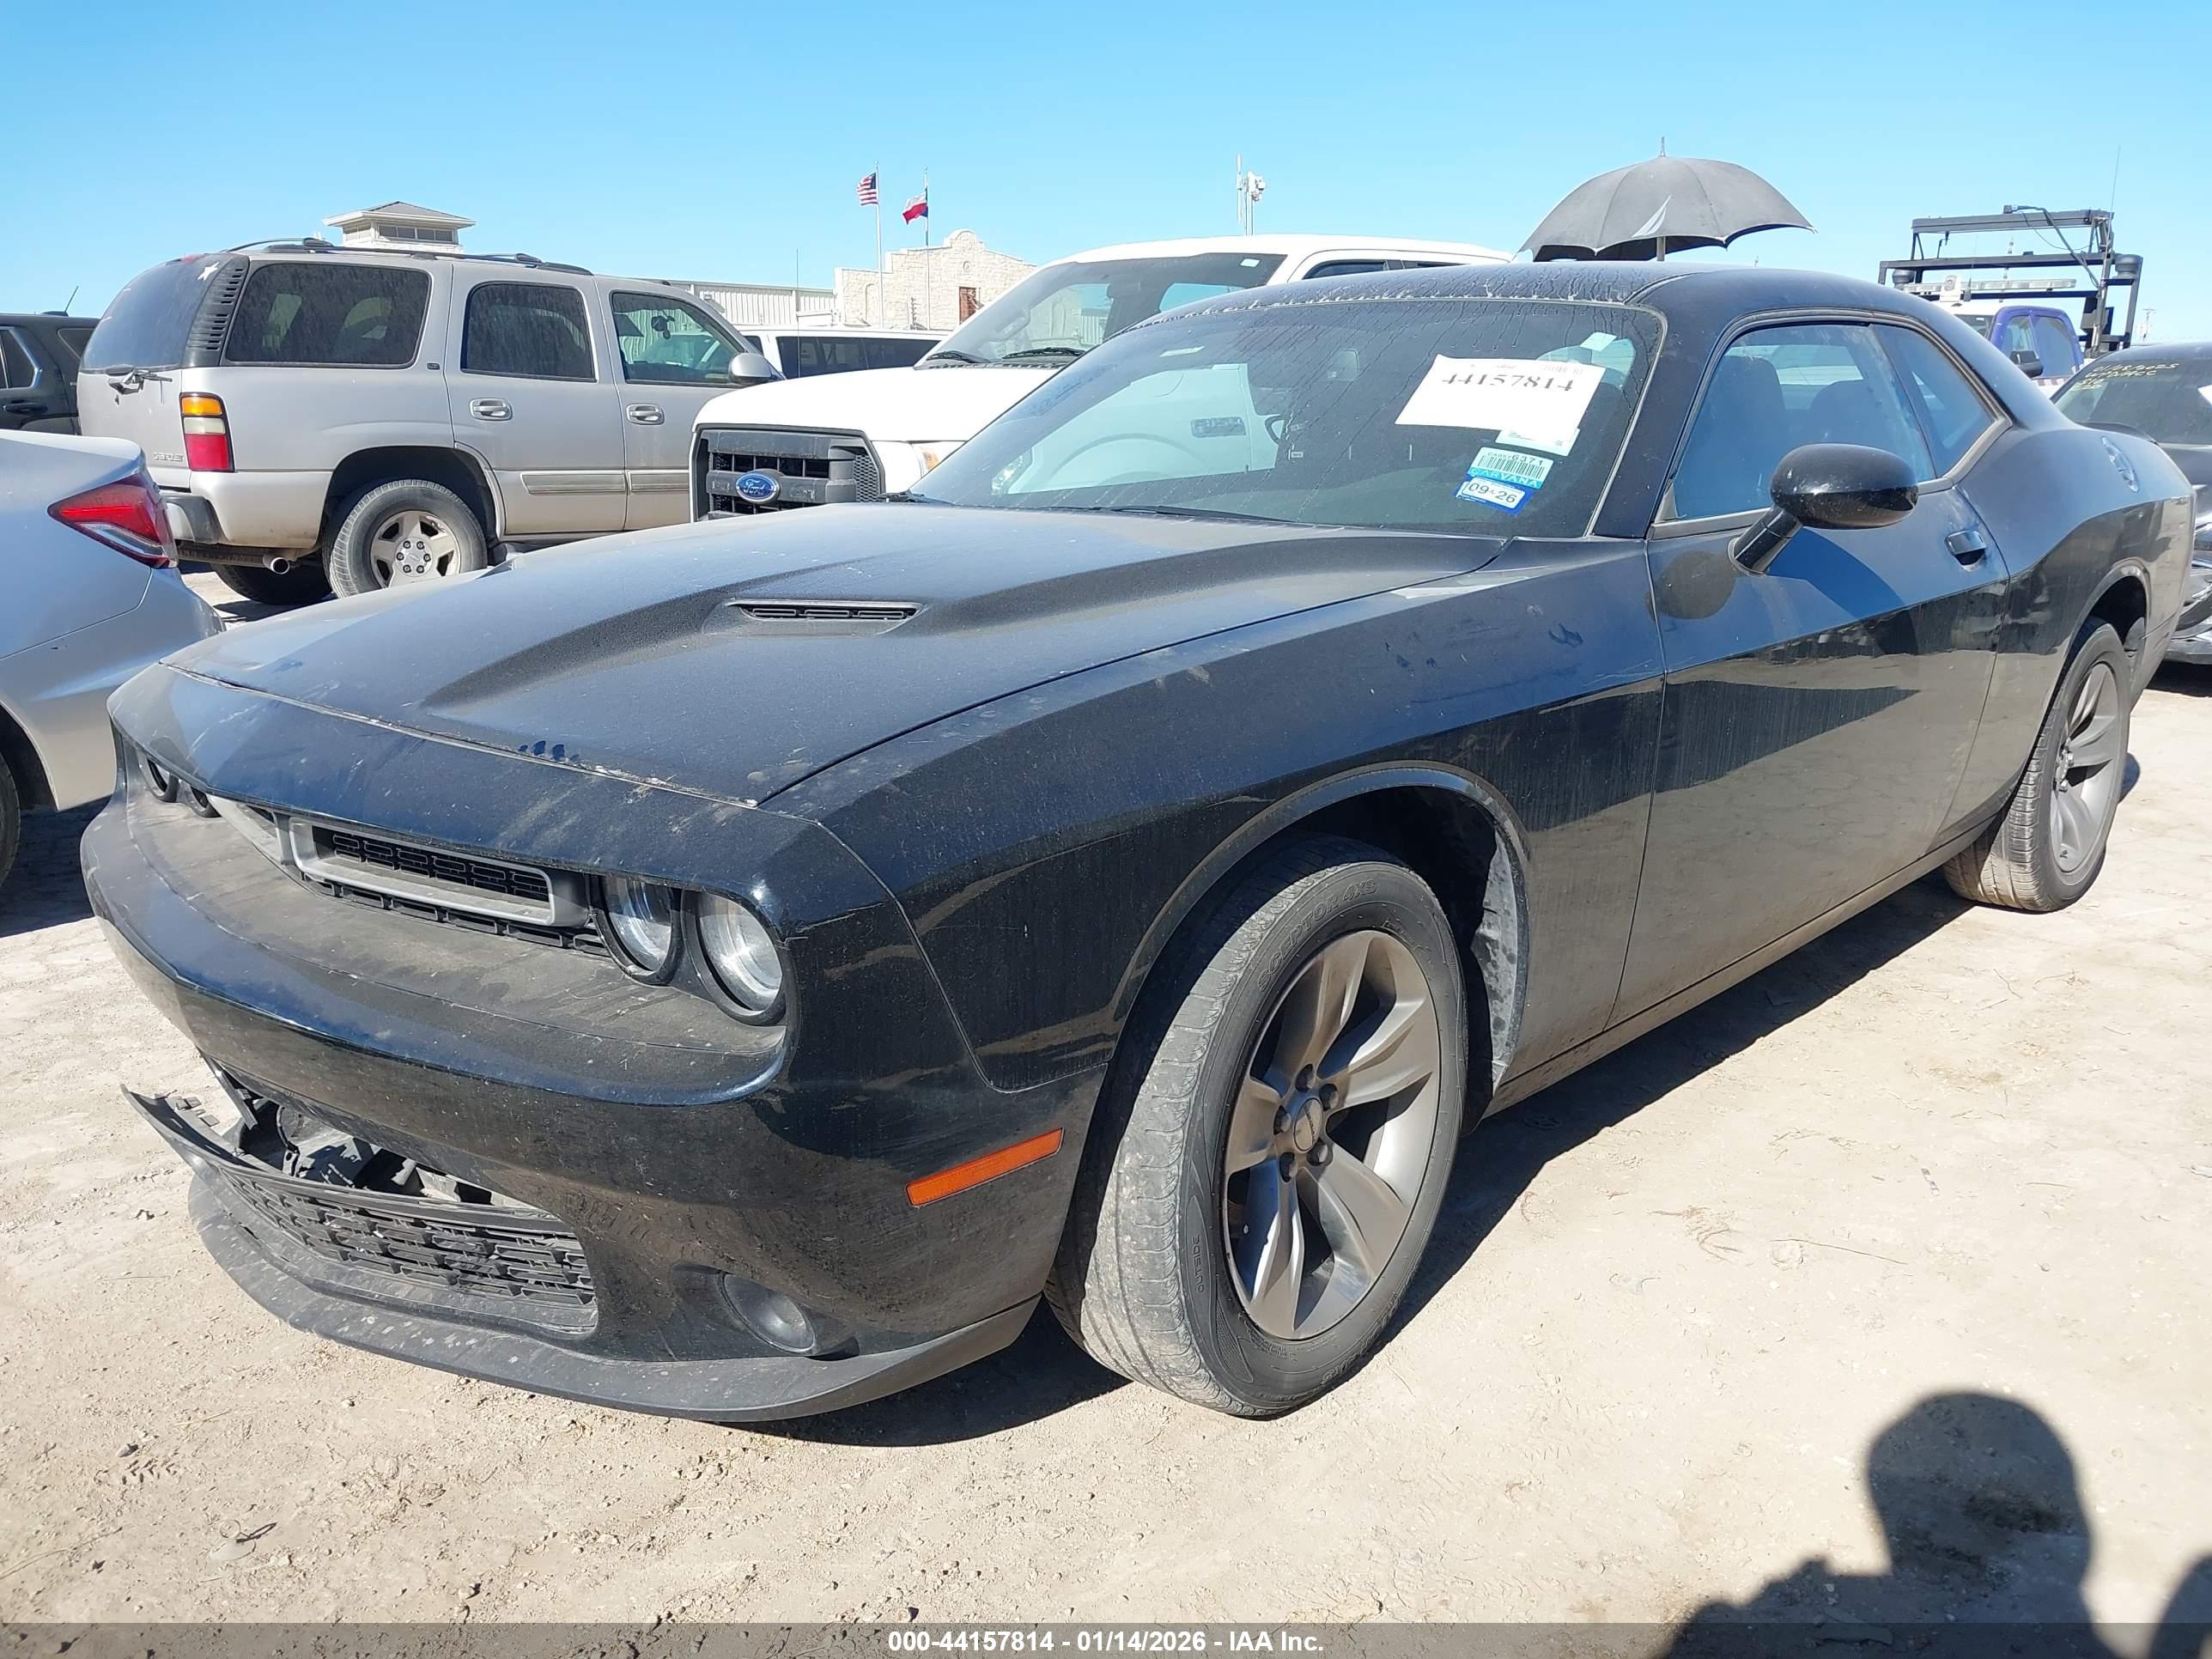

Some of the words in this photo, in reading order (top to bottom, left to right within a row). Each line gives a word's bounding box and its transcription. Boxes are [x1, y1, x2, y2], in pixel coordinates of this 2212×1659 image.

[1442, 373, 1574, 392] 44157814
[1470, 467, 1540, 488] CARVANA
[1468, 482, 1490, 495] 09
[1495, 490, 1518, 503] 26
[1257, 894, 1340, 992] SCEPTOR
[1191, 1235, 1205, 1293] OUTSIDE
